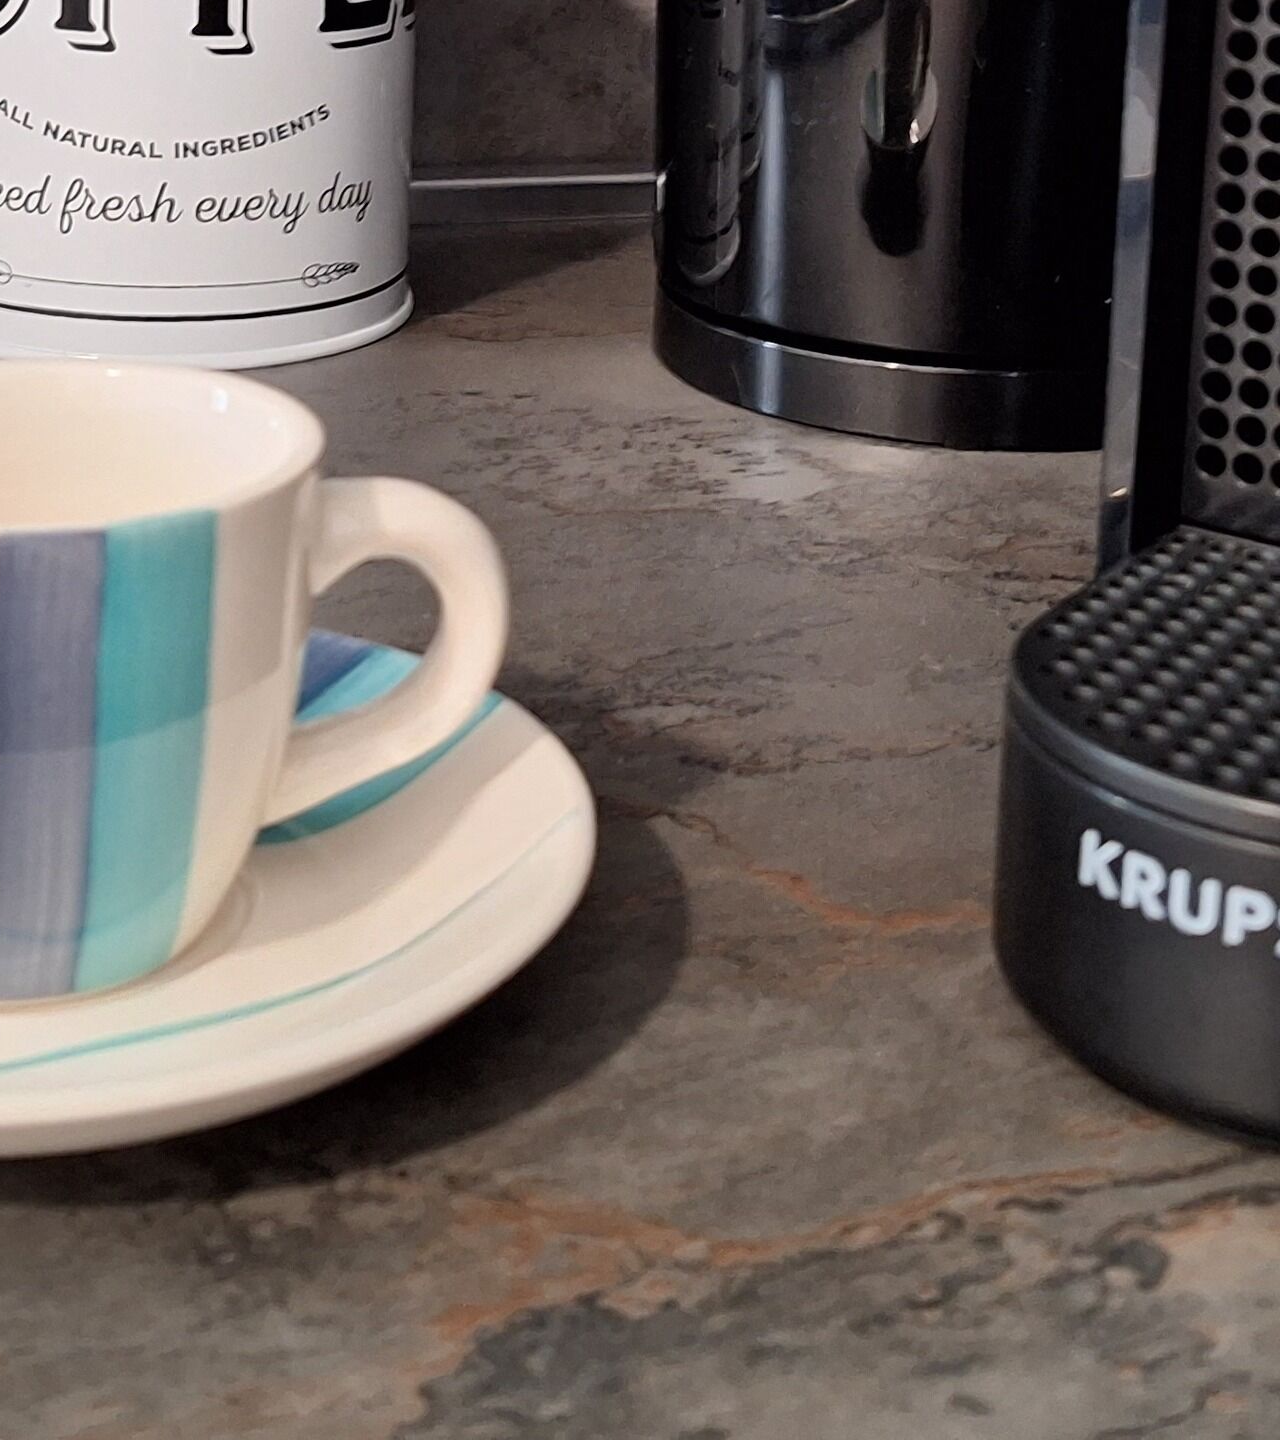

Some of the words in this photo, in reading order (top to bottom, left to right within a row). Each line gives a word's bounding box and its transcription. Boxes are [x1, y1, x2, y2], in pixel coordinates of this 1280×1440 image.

[43, 120, 163, 159] NATURAL
[174, 103, 331, 159] INGREDIENTS
[59, 177, 184, 235] fresh
[194, 186, 311, 235] every
[317, 171, 374, 223] day
